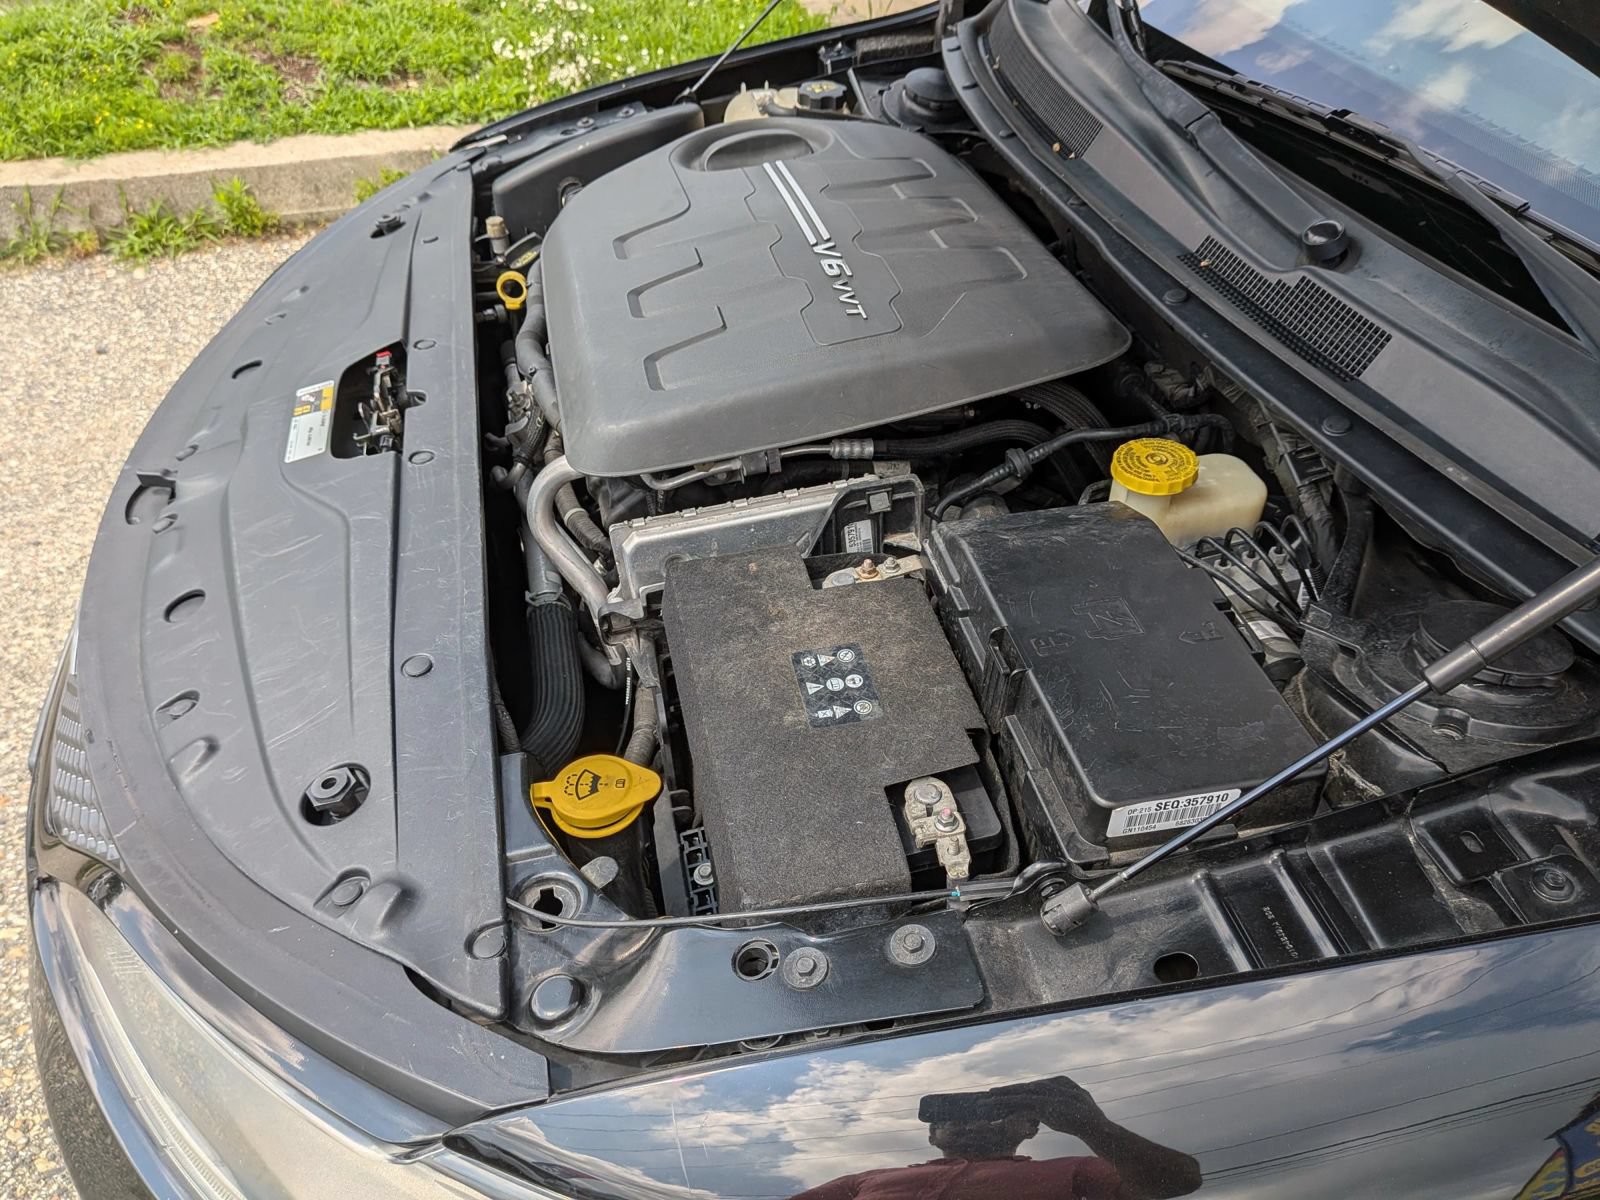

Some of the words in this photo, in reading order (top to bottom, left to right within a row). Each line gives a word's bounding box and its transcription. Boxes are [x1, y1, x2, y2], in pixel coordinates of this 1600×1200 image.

[812, 242, 853, 277] V6
[832, 279, 868, 320] VVT
[1155, 793, 1229, 812] SEQ:357910
